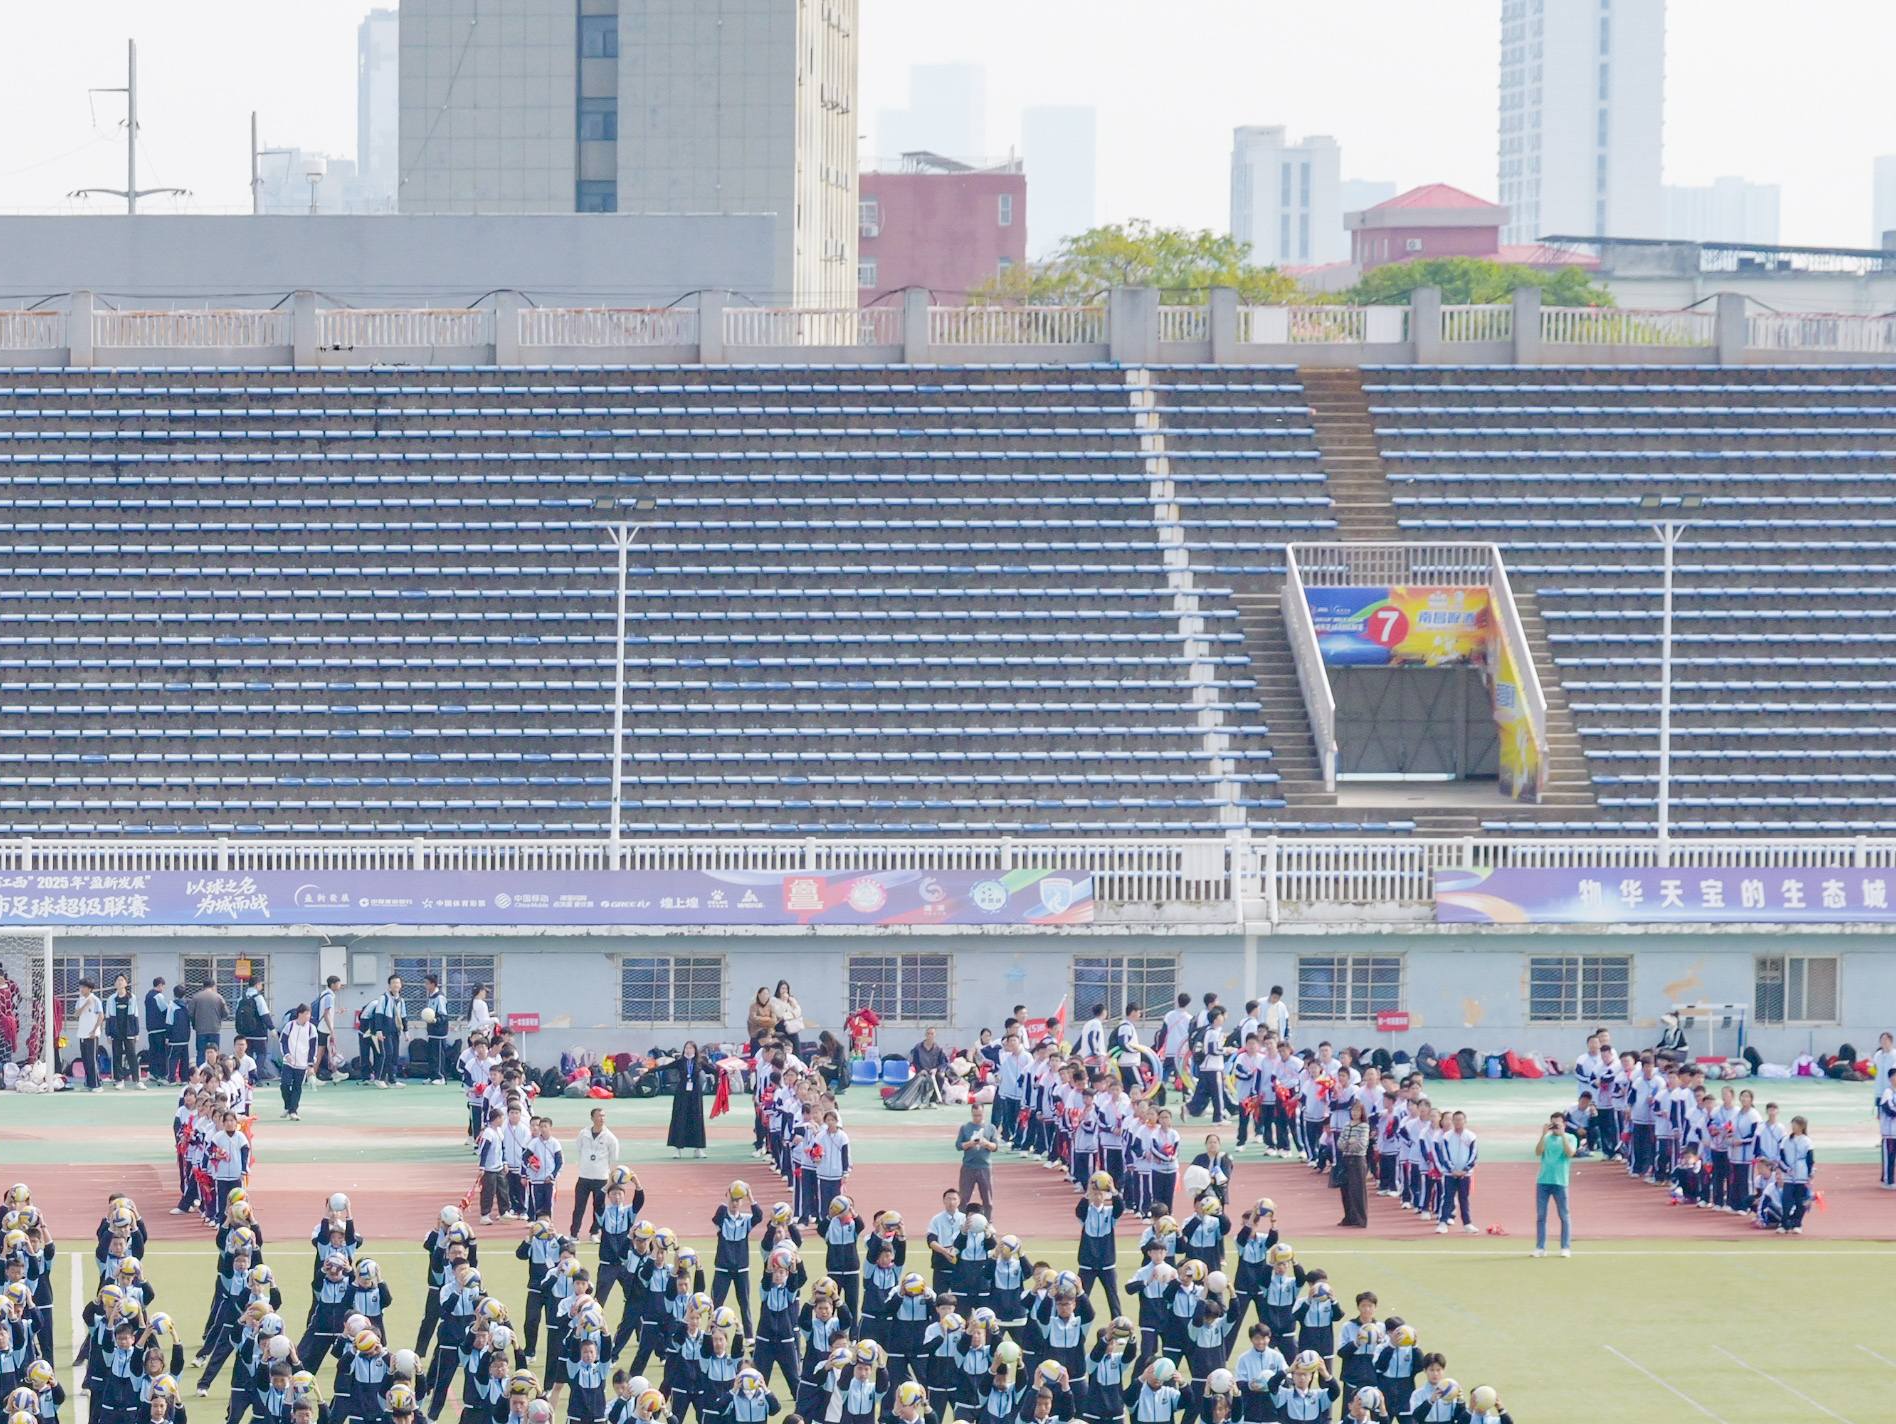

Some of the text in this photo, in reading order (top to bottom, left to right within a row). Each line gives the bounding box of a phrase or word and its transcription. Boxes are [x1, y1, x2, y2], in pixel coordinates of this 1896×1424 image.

[1377, 611, 1400, 642] 7
[186, 876, 257, 896] 以球之名
[1579, 879, 1888, 909] 物华天宝的生态城
[194, 894, 270, 919] 为城而战
